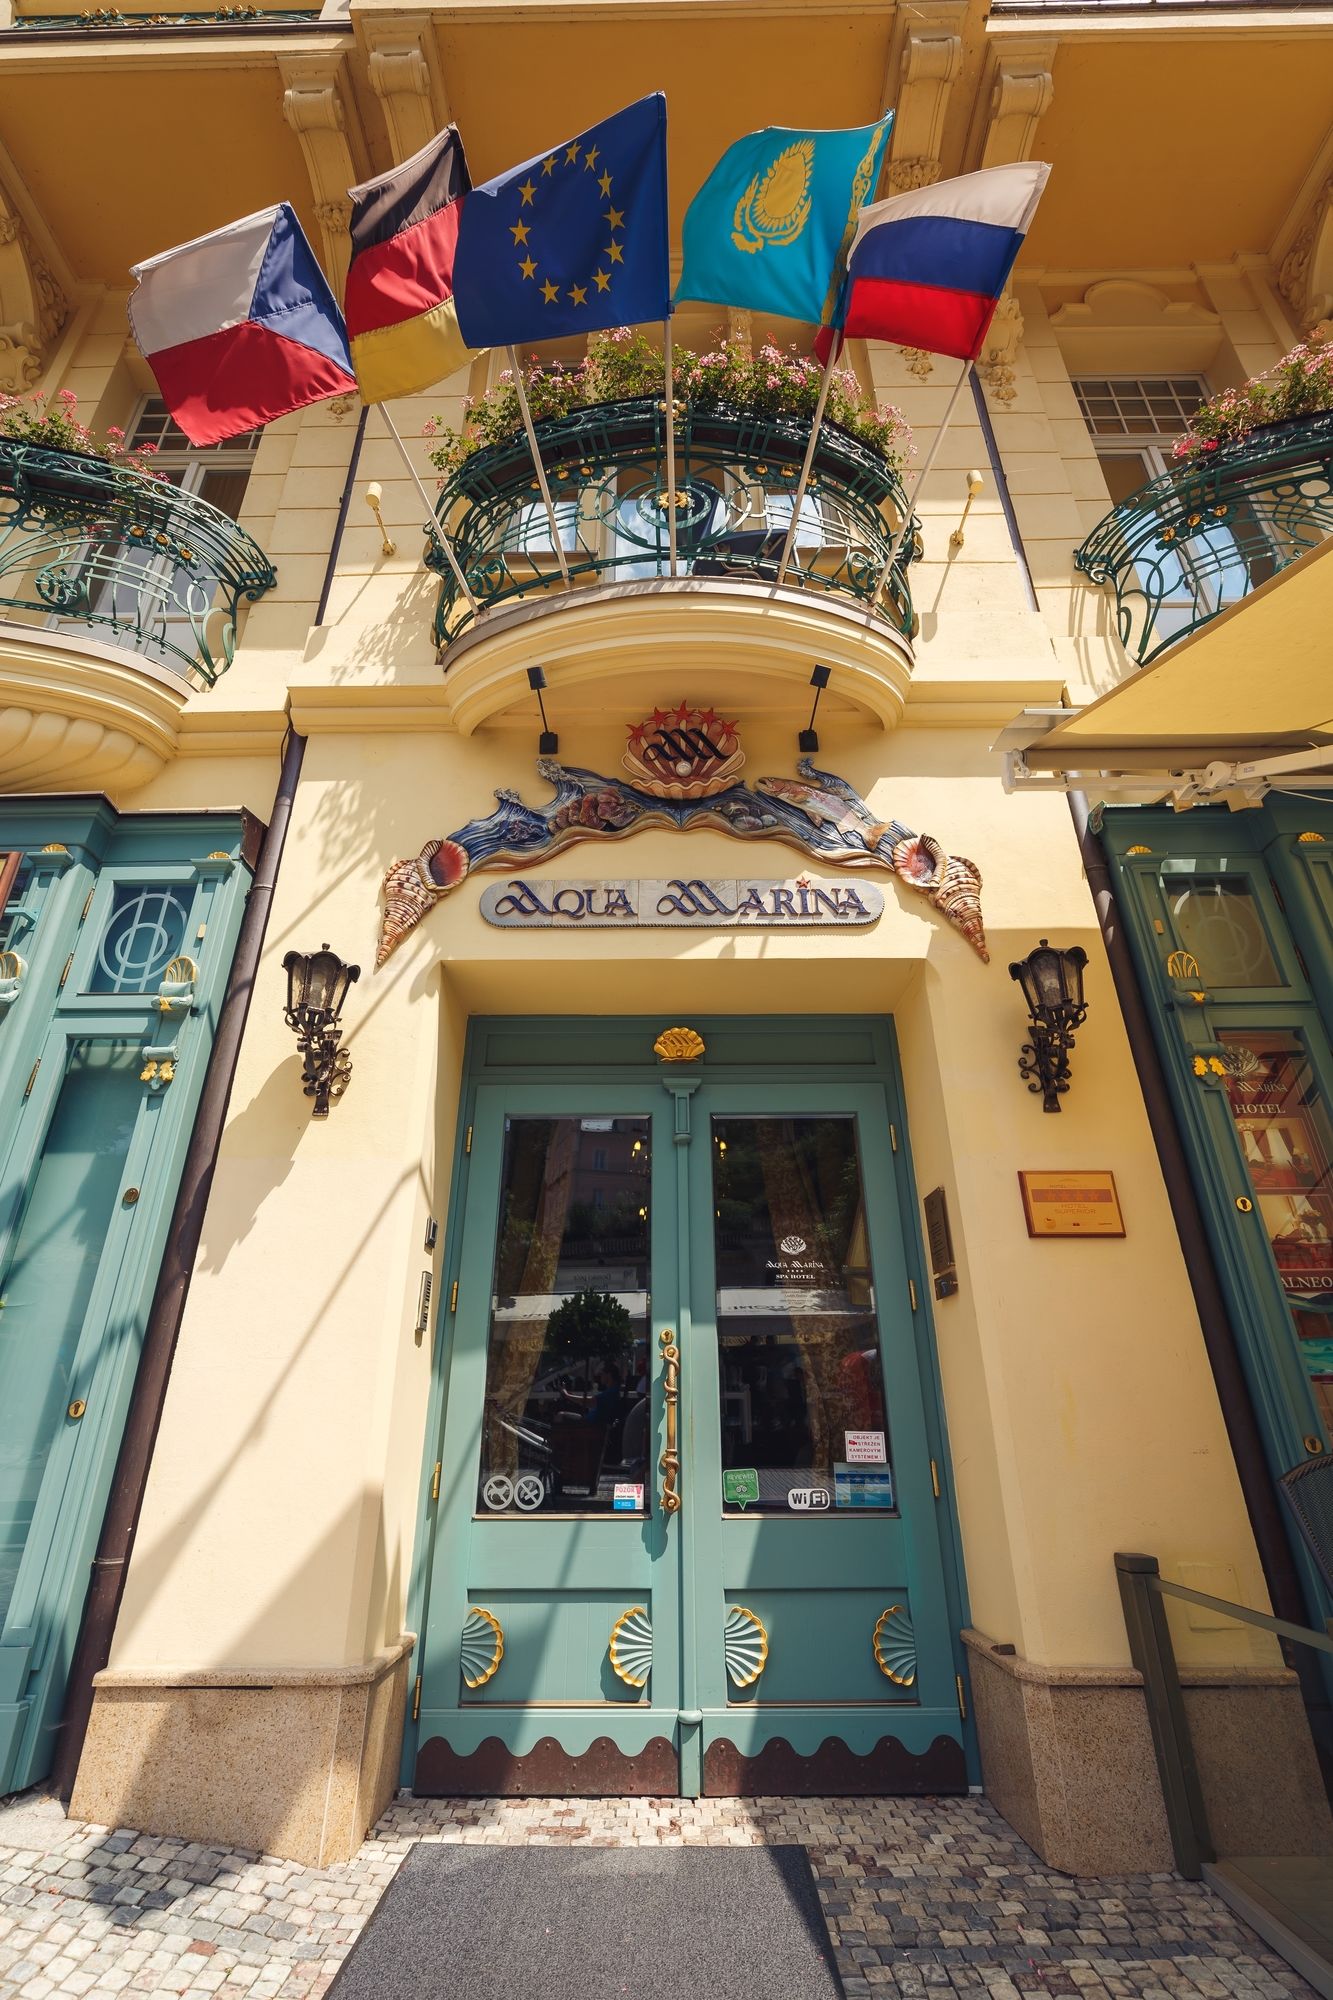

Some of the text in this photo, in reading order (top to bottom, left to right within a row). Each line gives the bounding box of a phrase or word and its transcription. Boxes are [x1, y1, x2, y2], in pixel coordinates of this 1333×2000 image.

[494, 878, 871, 920] AQUA MARINA
[1235, 1103, 1286, 1114] HOTEL
[765, 1260, 824, 1269] AQUA MARINA
